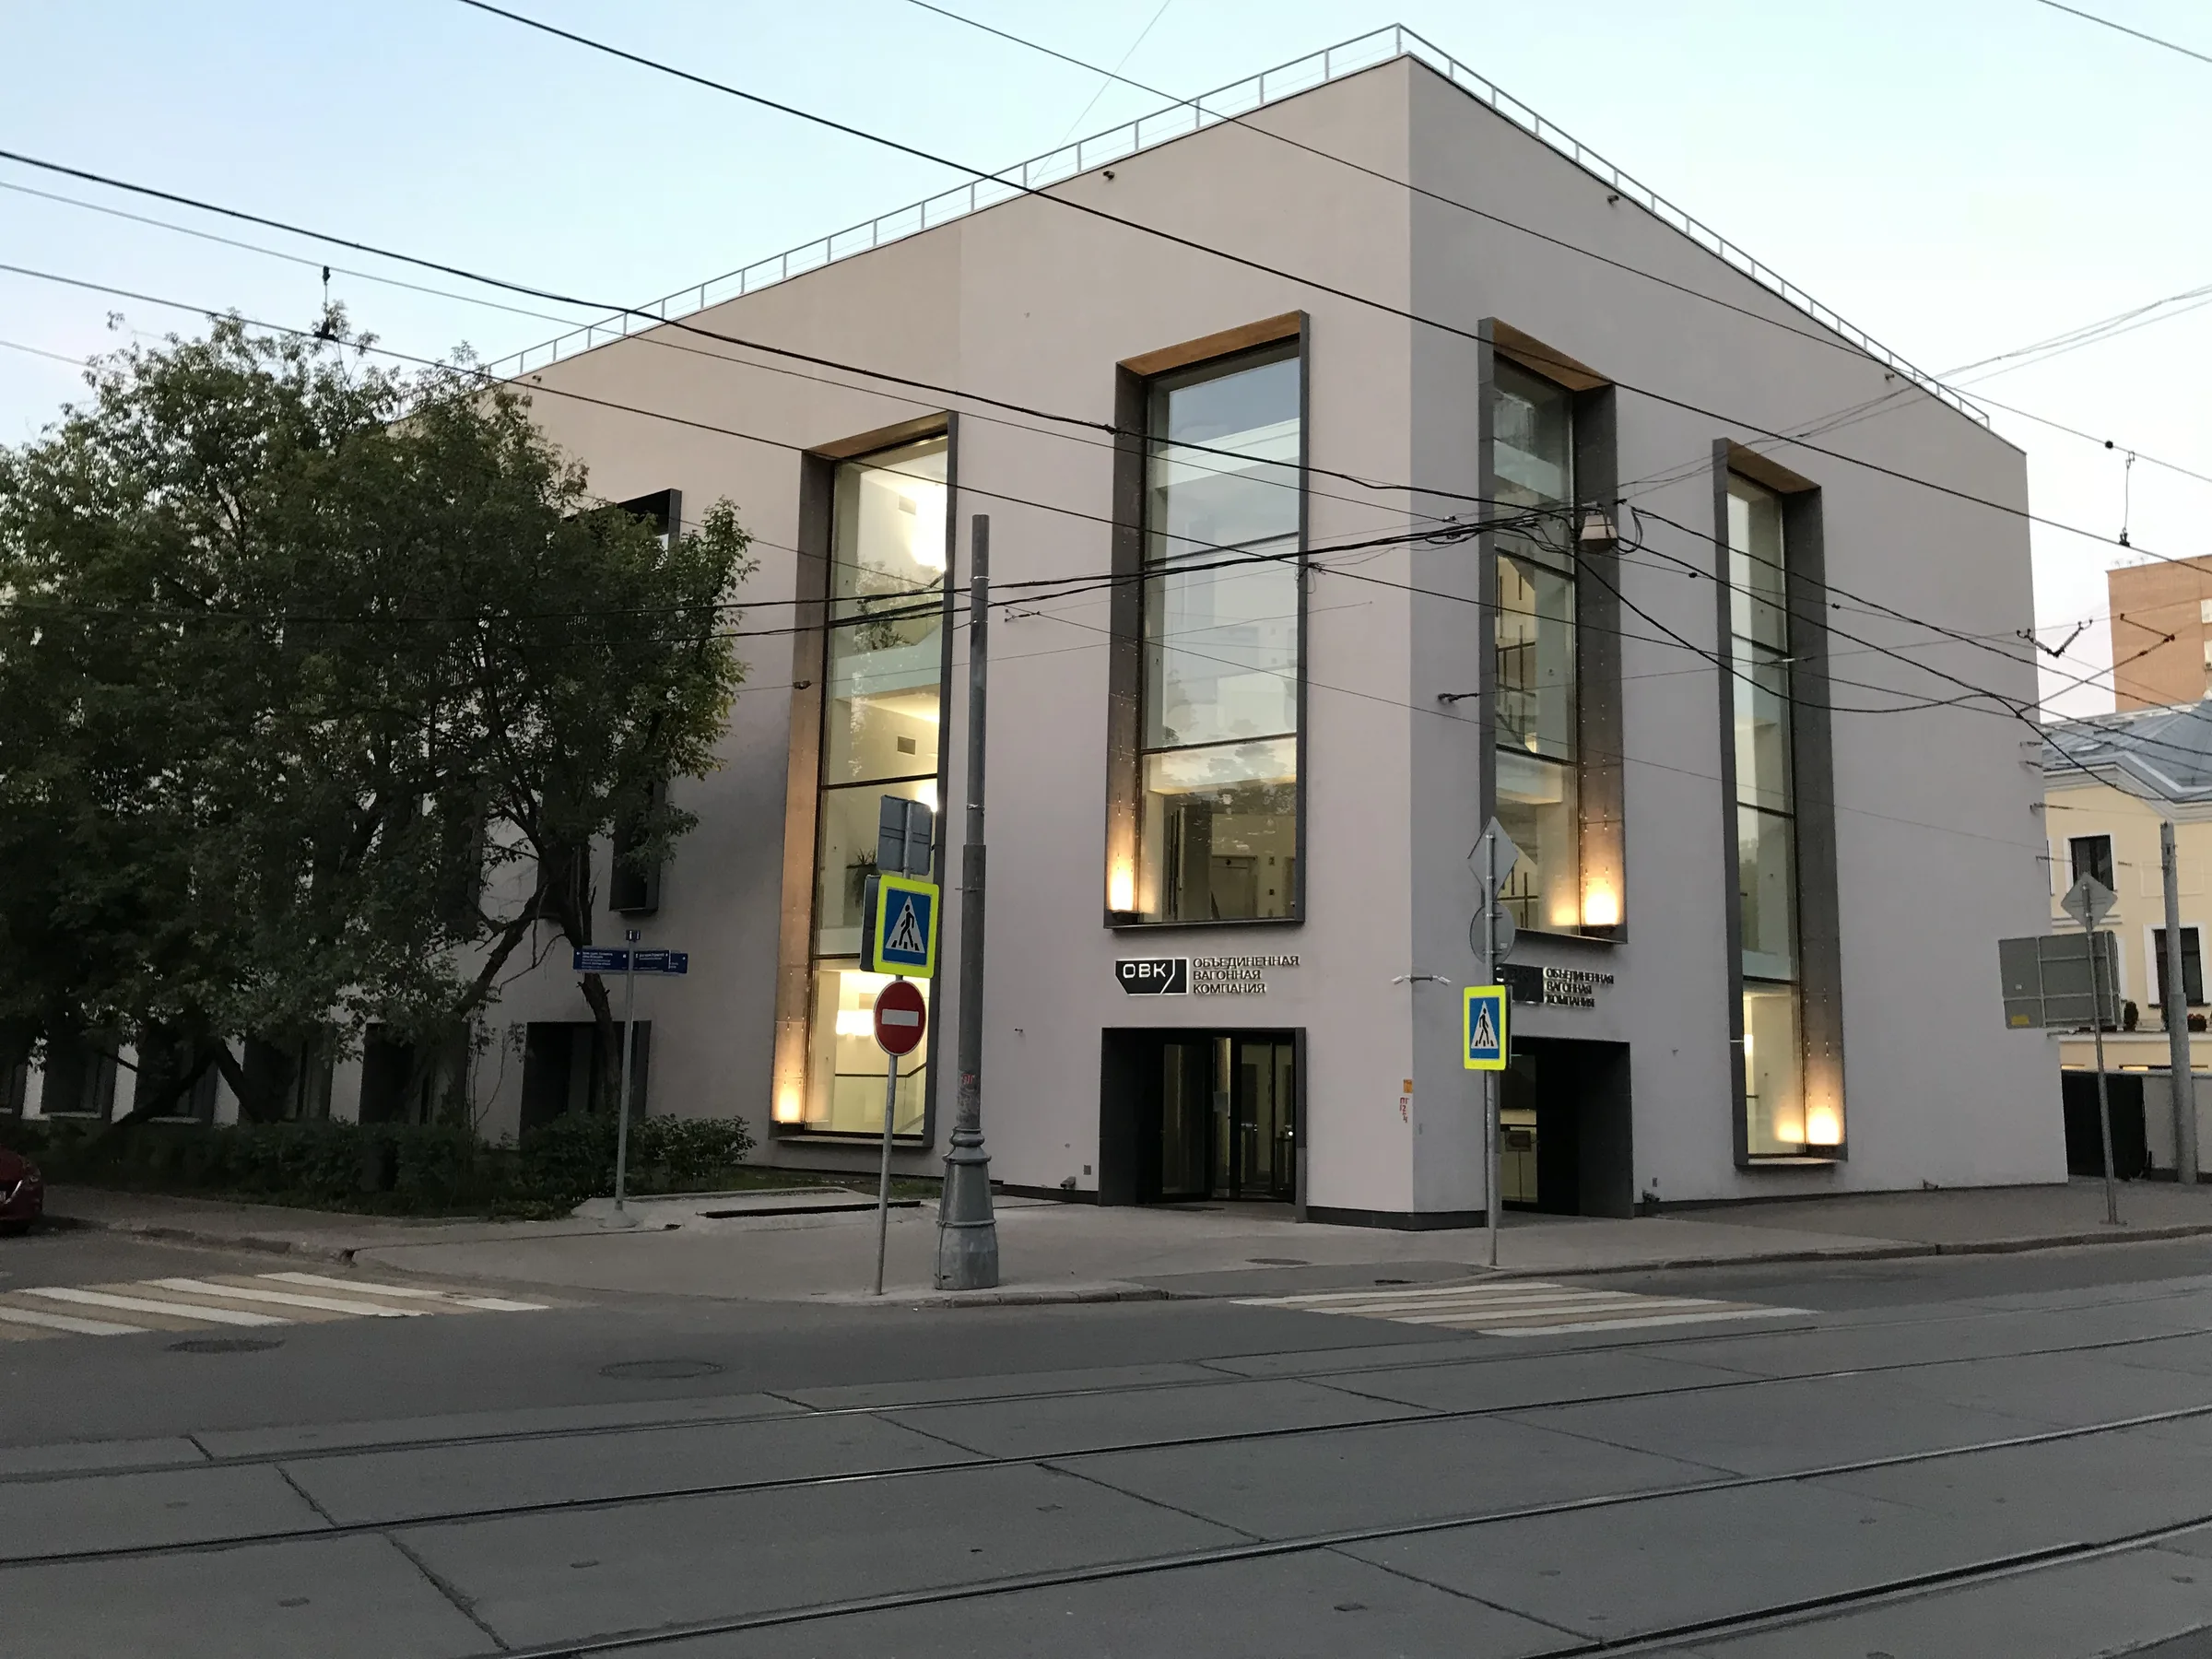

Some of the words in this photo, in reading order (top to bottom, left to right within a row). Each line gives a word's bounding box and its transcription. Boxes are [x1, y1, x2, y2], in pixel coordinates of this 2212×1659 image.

[1193, 956, 1300, 969] ОБЪЕДИНЕННАЯ
[1123, 963, 1167, 979] ОВК
[1193, 970, 1262, 981] ВАГОННАЯ
[1193, 983, 1266, 994] КОМПАНИЯ
